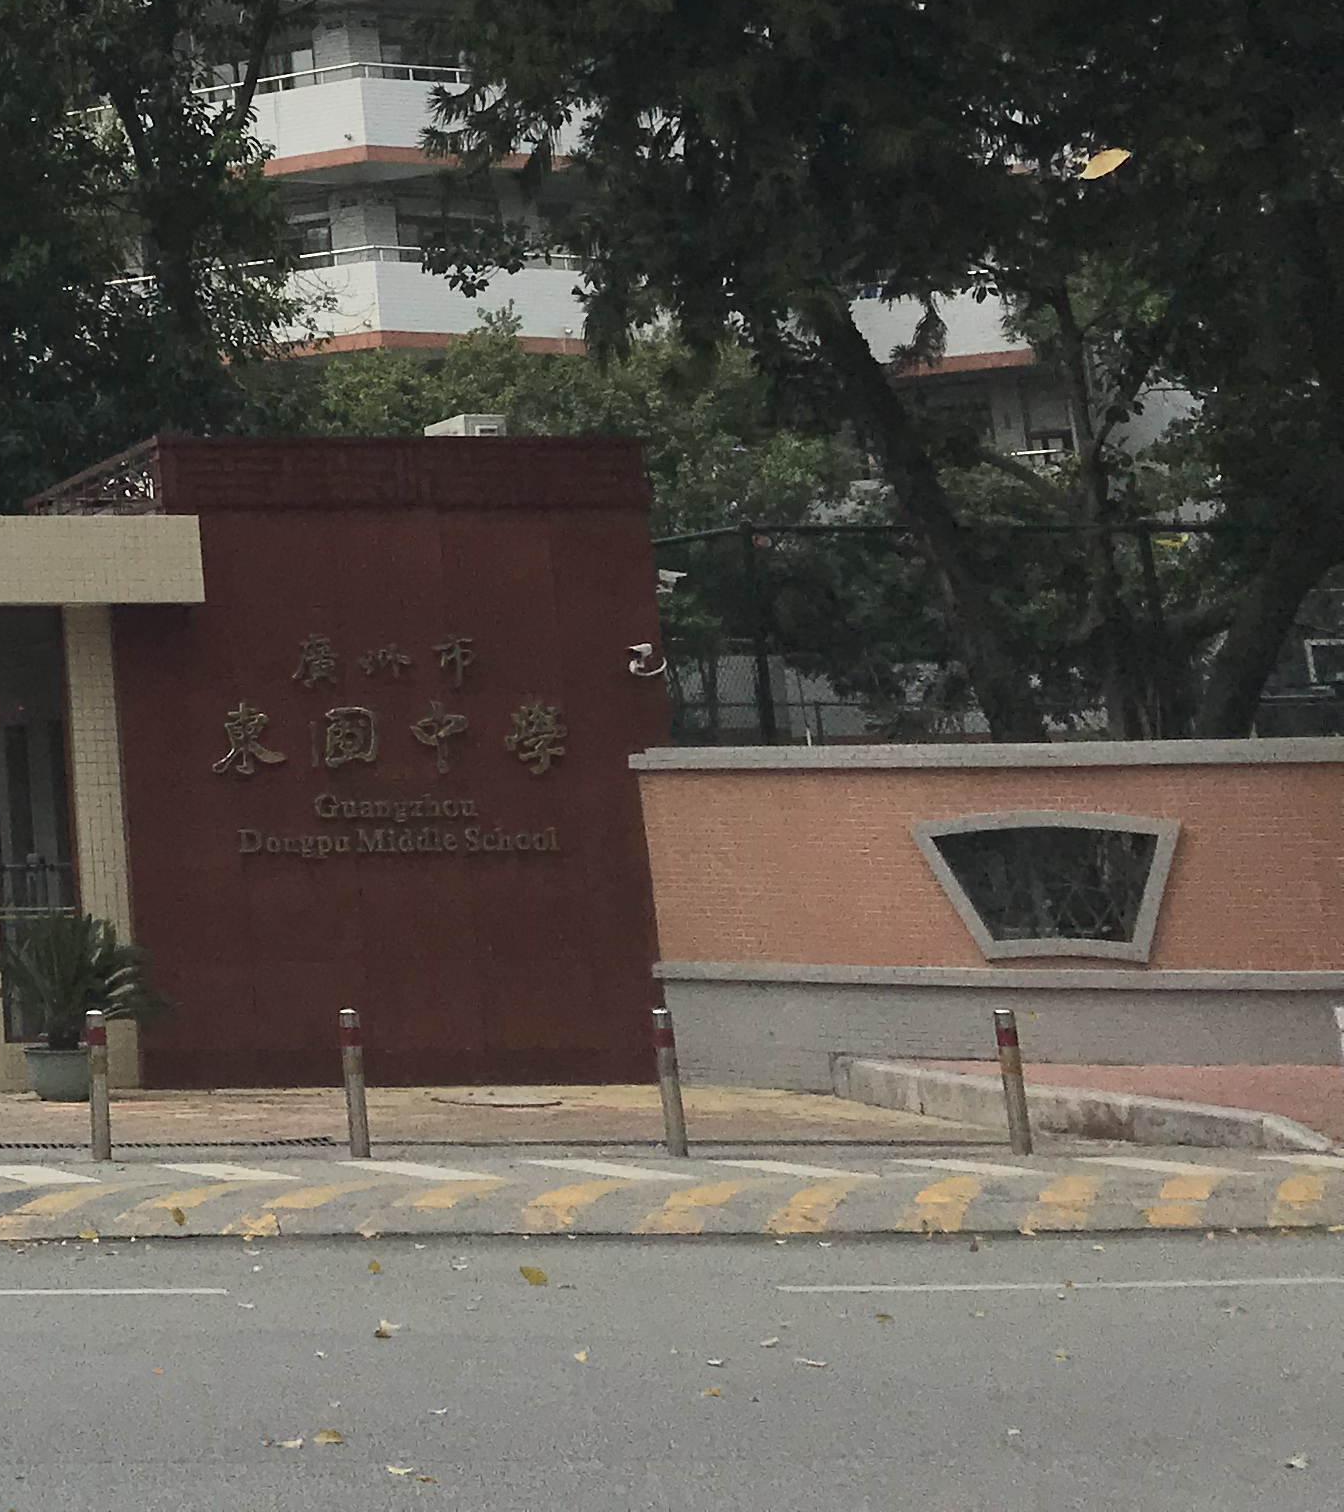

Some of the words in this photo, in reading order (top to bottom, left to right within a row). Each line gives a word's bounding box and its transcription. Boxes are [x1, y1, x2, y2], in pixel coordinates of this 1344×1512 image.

[314, 793, 479, 822] Guangzhou
[237, 828, 351, 858] Dongpu
[356, 826, 459, 853] Middle
[465, 826, 562, 852] School
